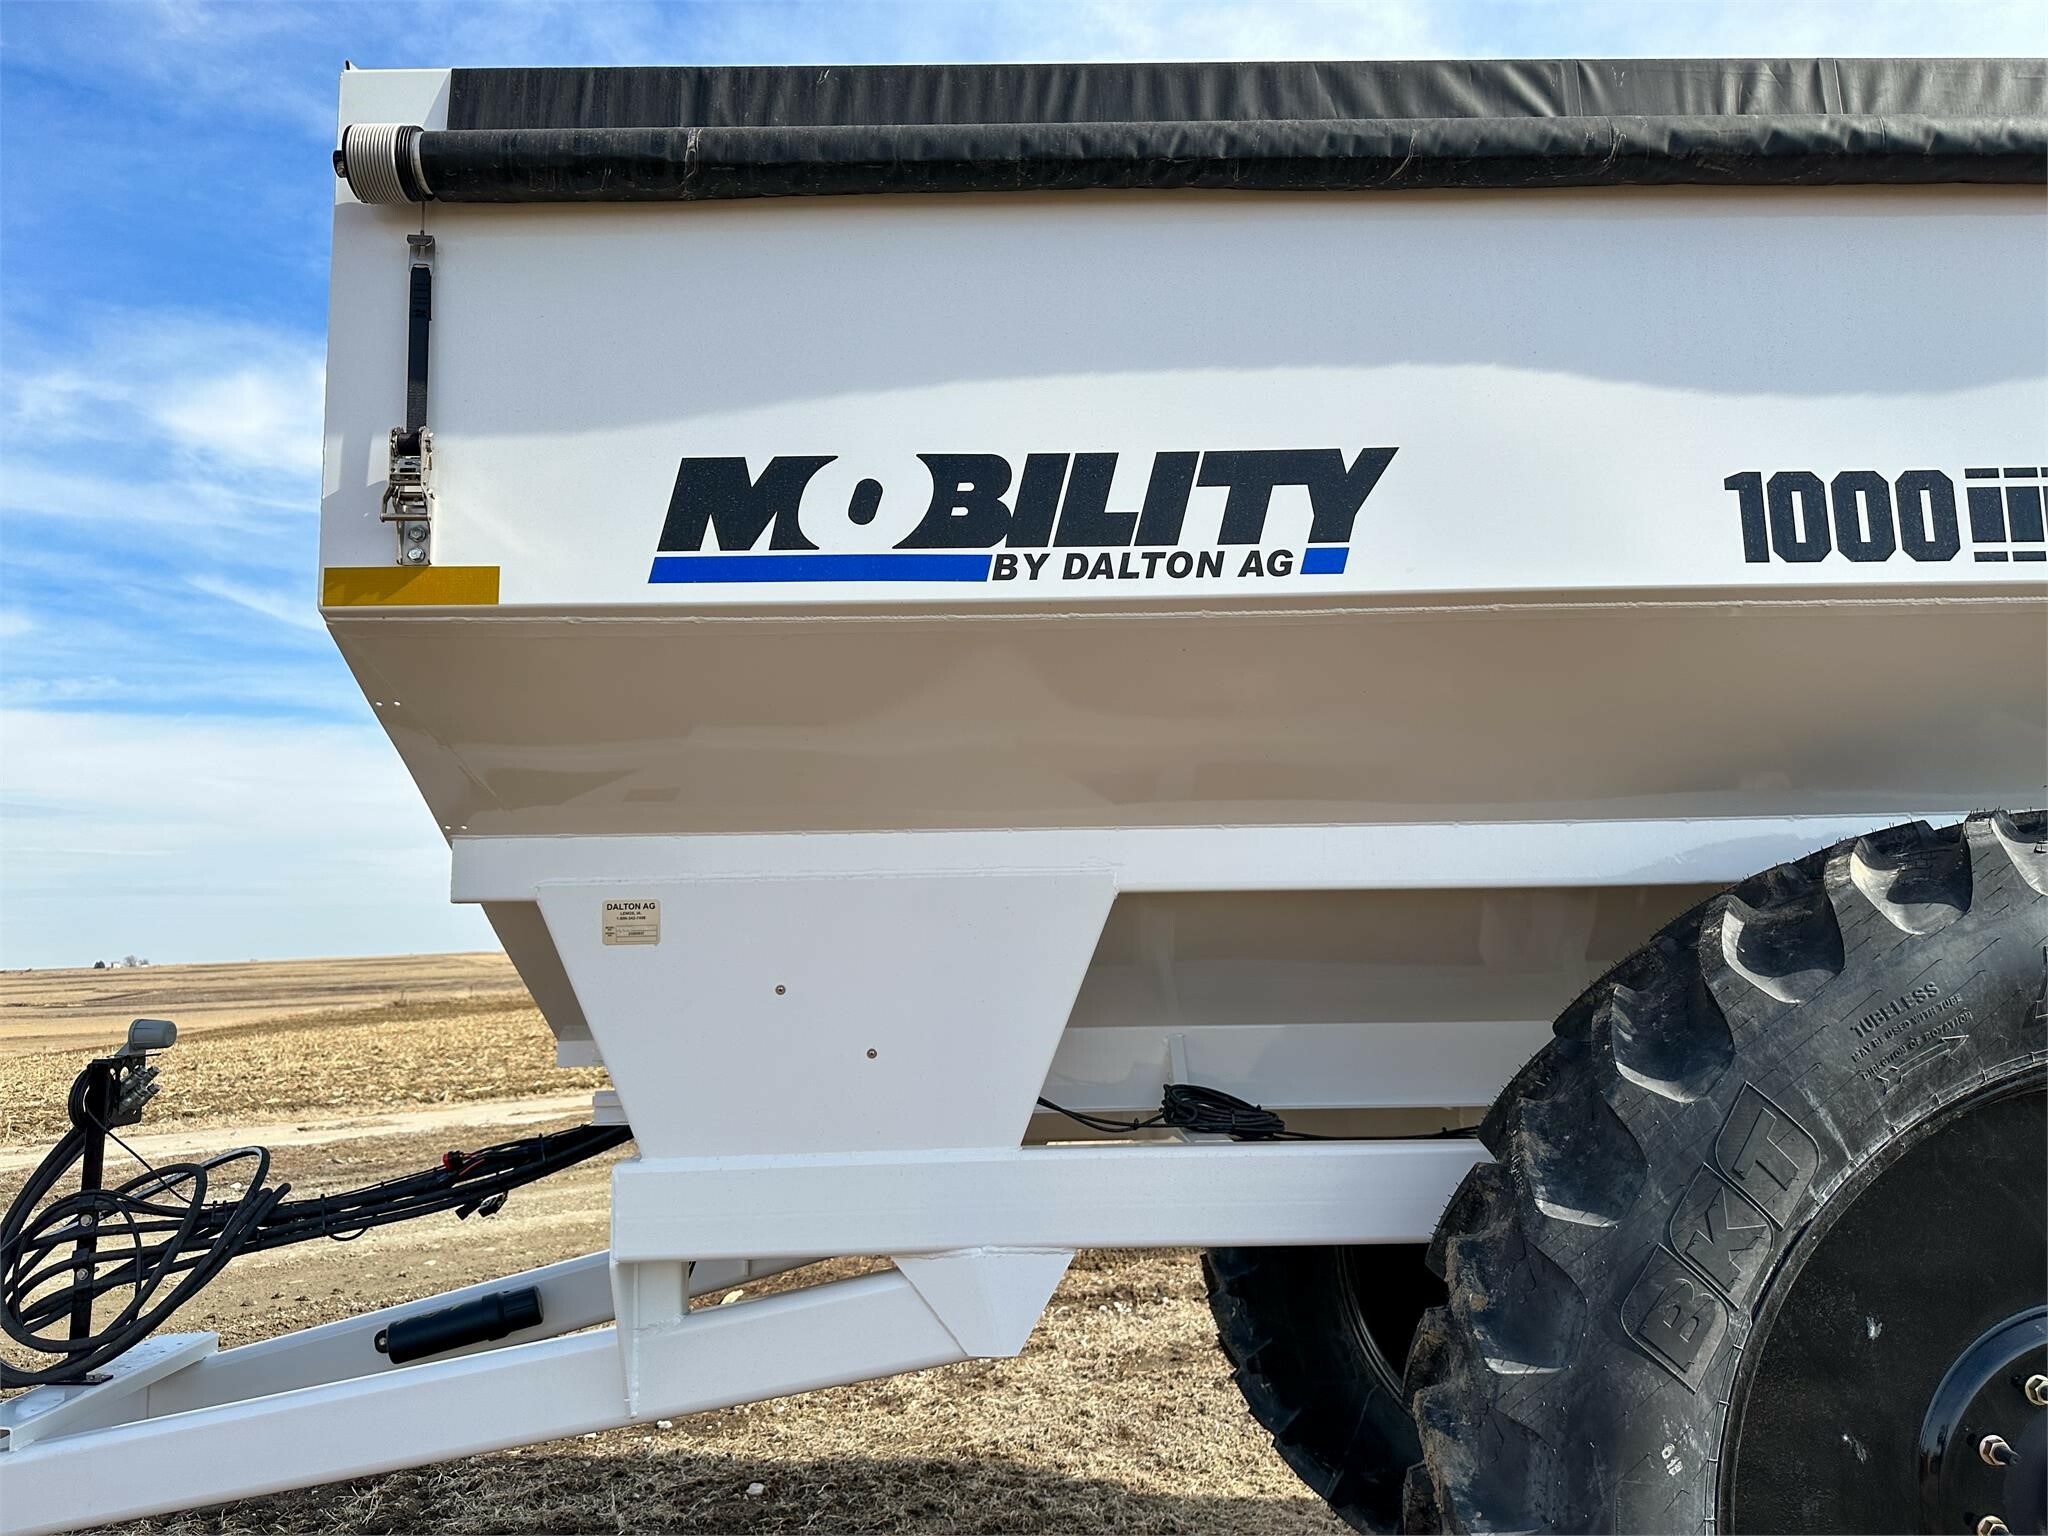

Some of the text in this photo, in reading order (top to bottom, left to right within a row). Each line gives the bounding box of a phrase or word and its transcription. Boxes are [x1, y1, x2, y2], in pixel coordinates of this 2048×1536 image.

[656, 446, 1399, 551] MOBILITY
[1723, 469, 1961, 563] 1000
[991, 549, 1294, 582] BY DALTON AG
[606, 902, 656, 911] DALTON AG
[1849, 981, 1941, 1038] TUBELESS
[1909, 1007, 1938, 1026] WITH
[1936, 993, 1963, 1013] TUBE
[1921, 1010, 1974, 1042] ROTATION
[1636, 1104, 1802, 1376] BKT
